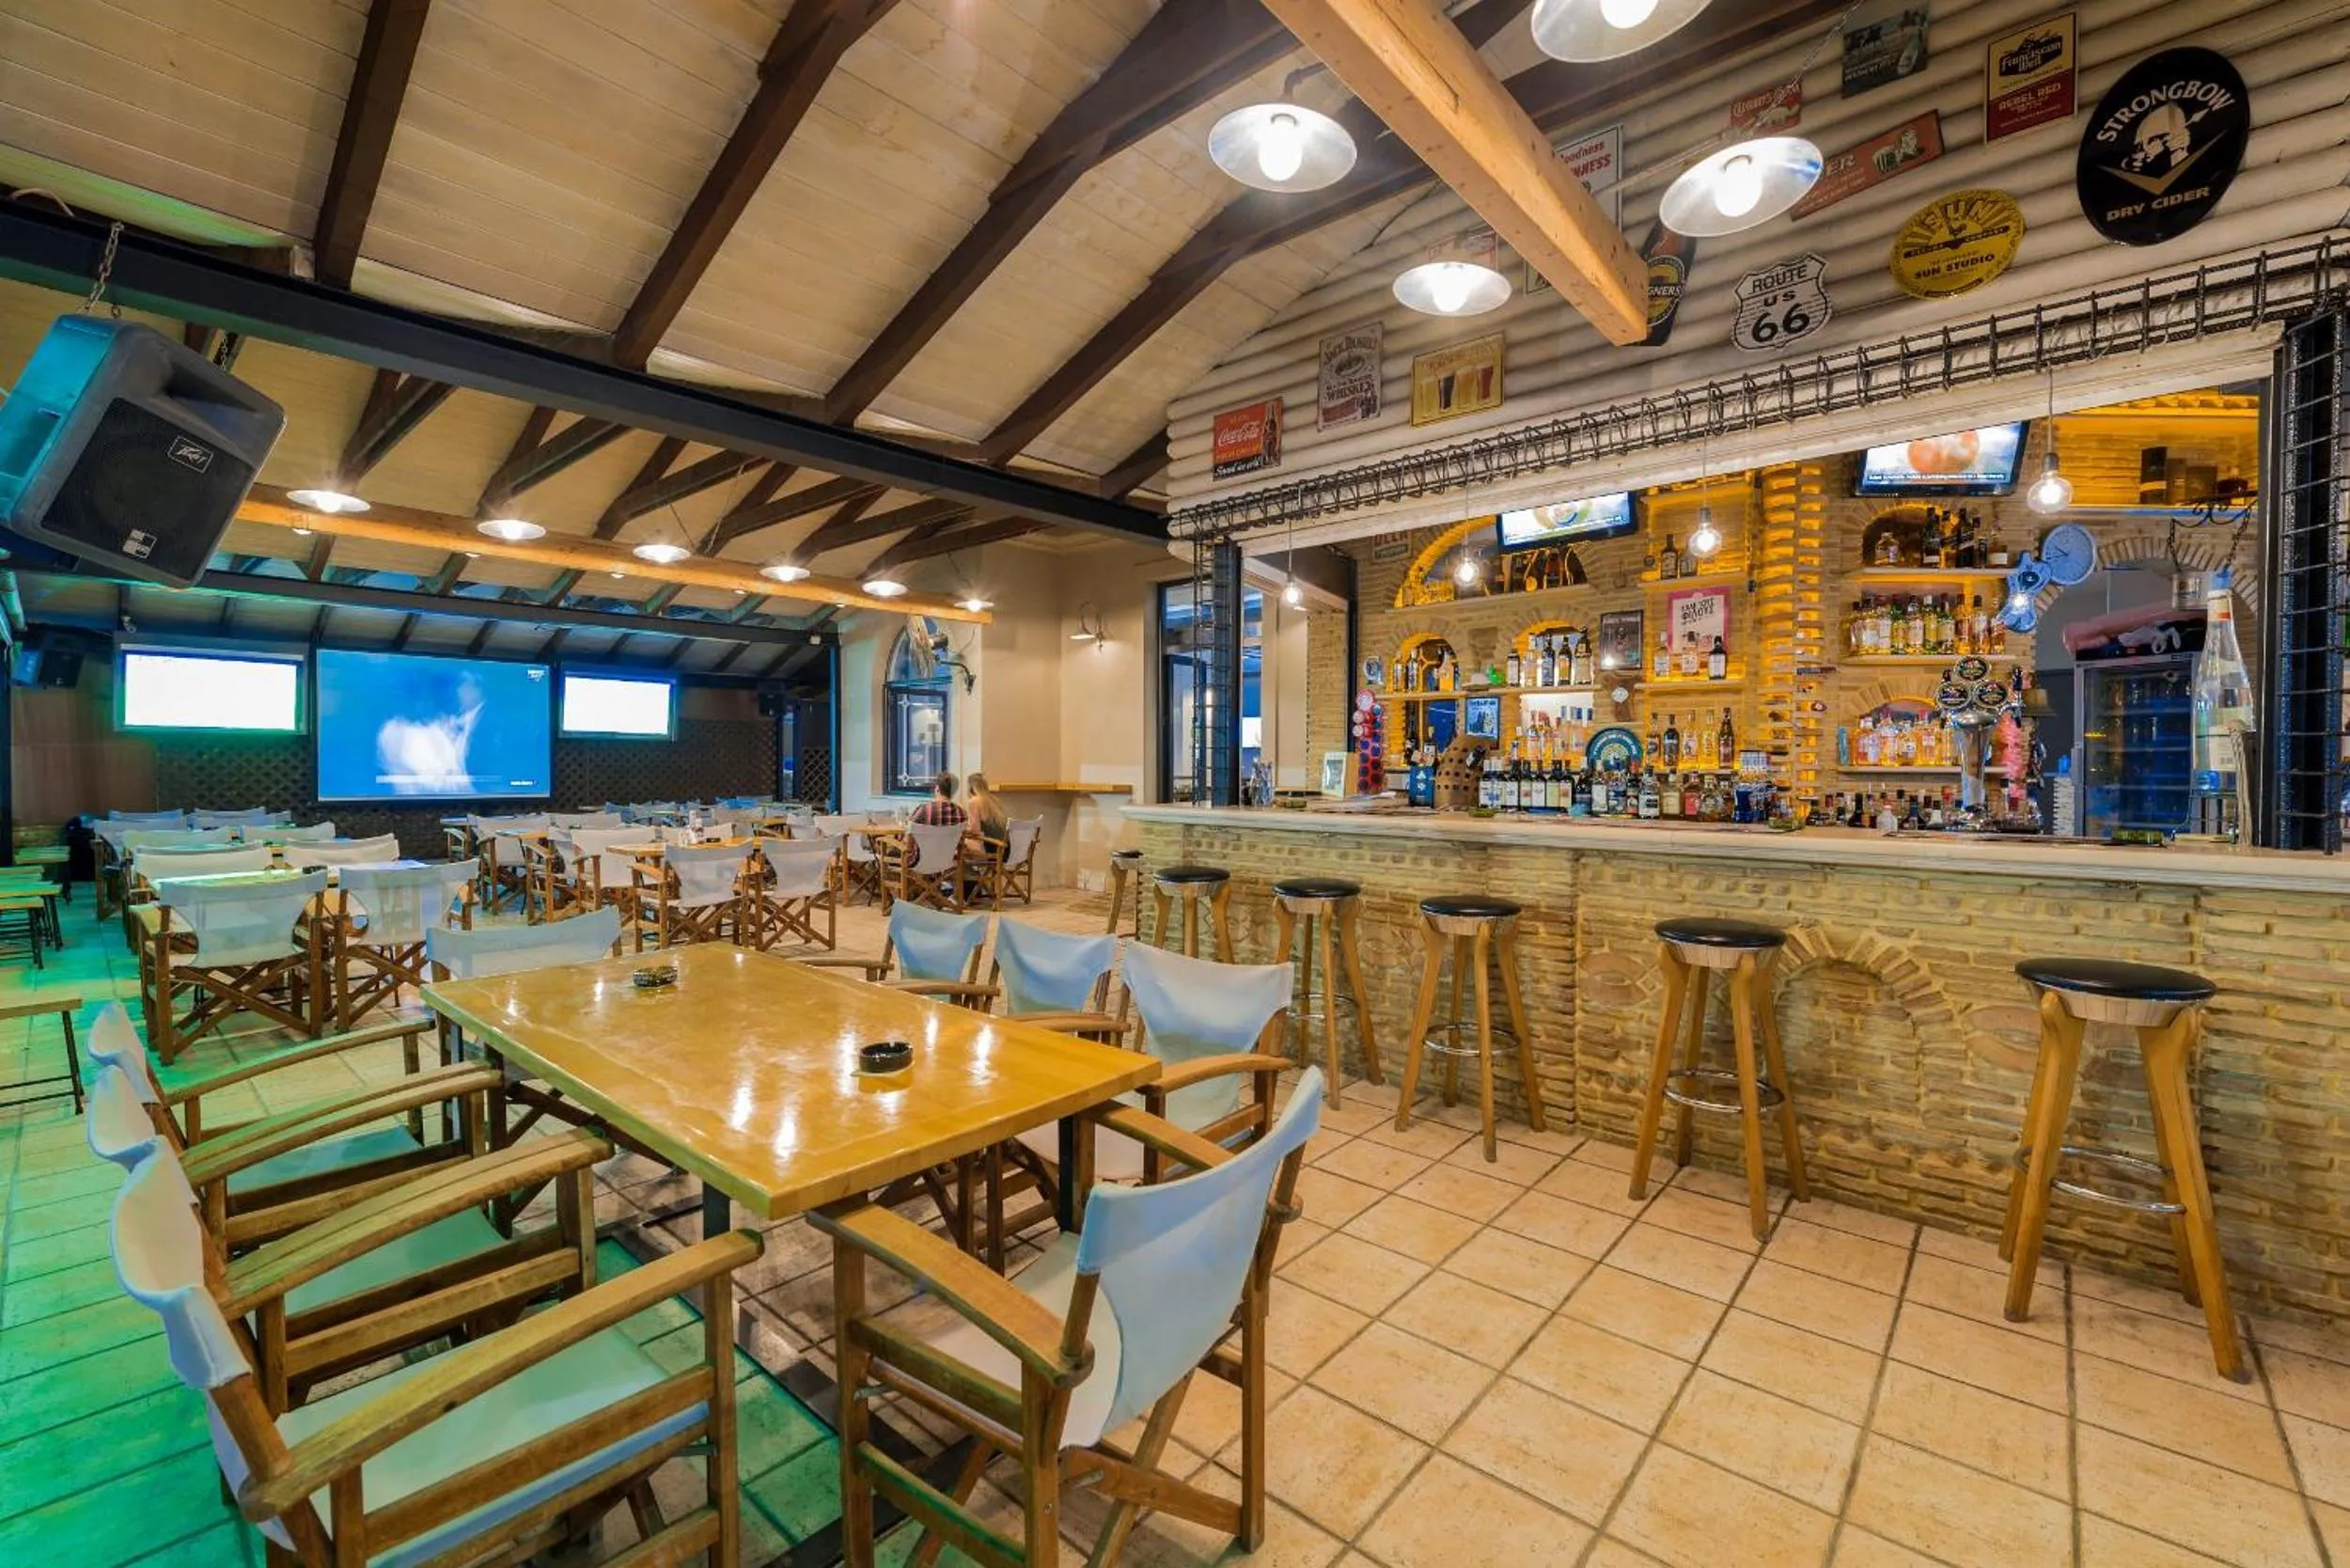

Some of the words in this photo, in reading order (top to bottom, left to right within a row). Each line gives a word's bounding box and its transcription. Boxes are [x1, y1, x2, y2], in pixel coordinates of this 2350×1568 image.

[2096, 80, 2236, 143] STRONGBOW
[1560, 140, 1606, 165] oodness
[2106, 202, 2145, 222] DRY
[2151, 186, 2210, 210] CIDER
[1751, 263, 1808, 293] ROUTE
[1914, 266, 1941, 280] SUN
[1945, 253, 1995, 273] STUDIO
[1646, 284, 1683, 296] GNERS
[1751, 303, 1810, 343] 66
